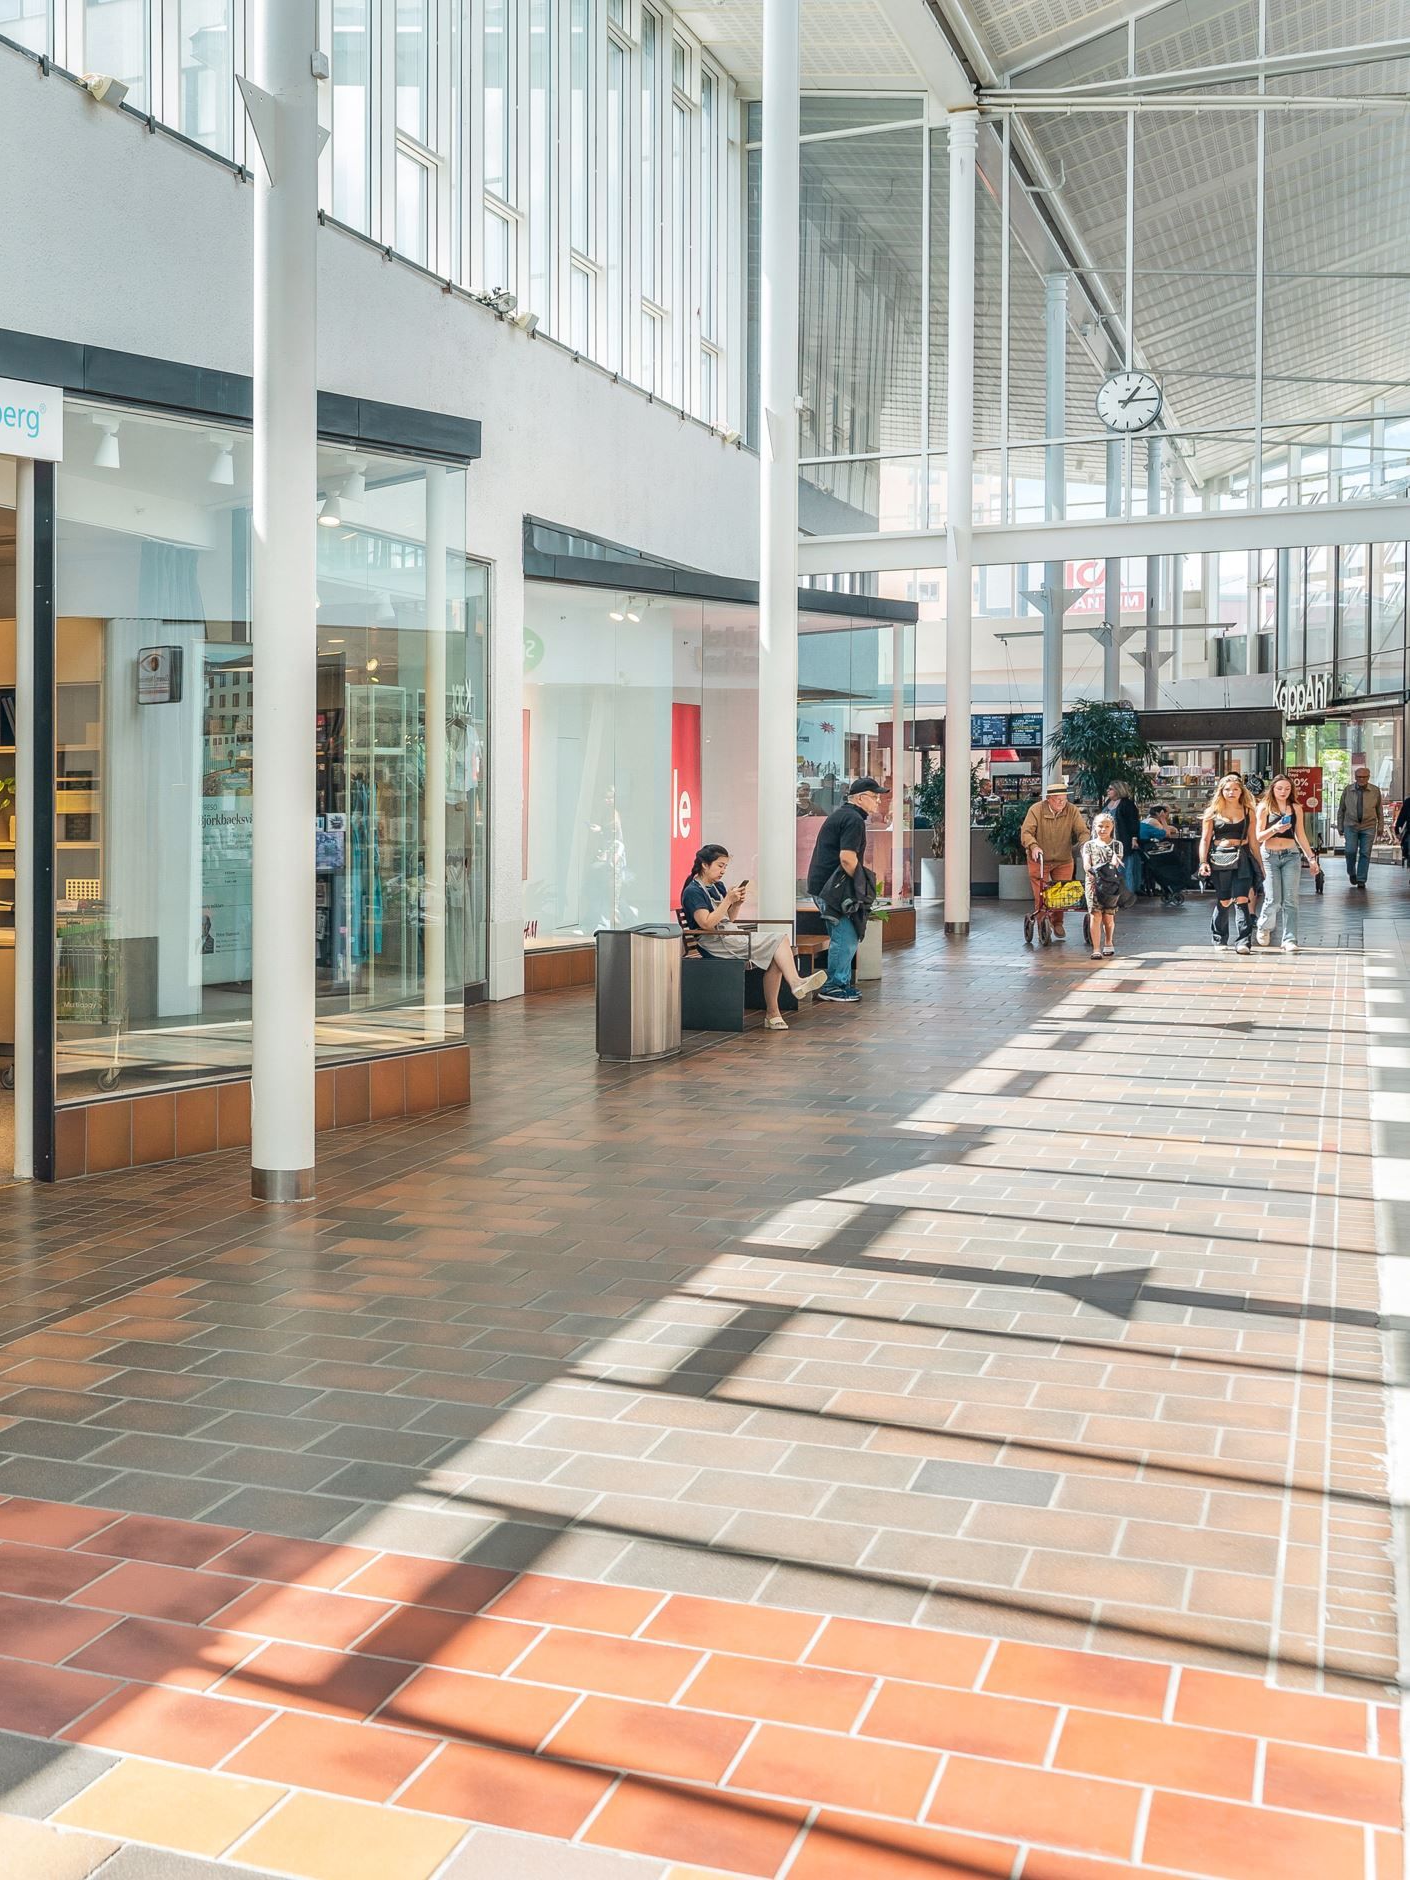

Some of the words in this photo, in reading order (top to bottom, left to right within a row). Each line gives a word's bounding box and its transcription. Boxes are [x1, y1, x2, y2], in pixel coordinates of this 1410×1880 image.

[1272, 672, 1328, 721] KappAhl
[1292, 777, 1309, 787] 0%
[673, 768, 692, 839] le
[201, 812, 253, 829] jörkbacksv
